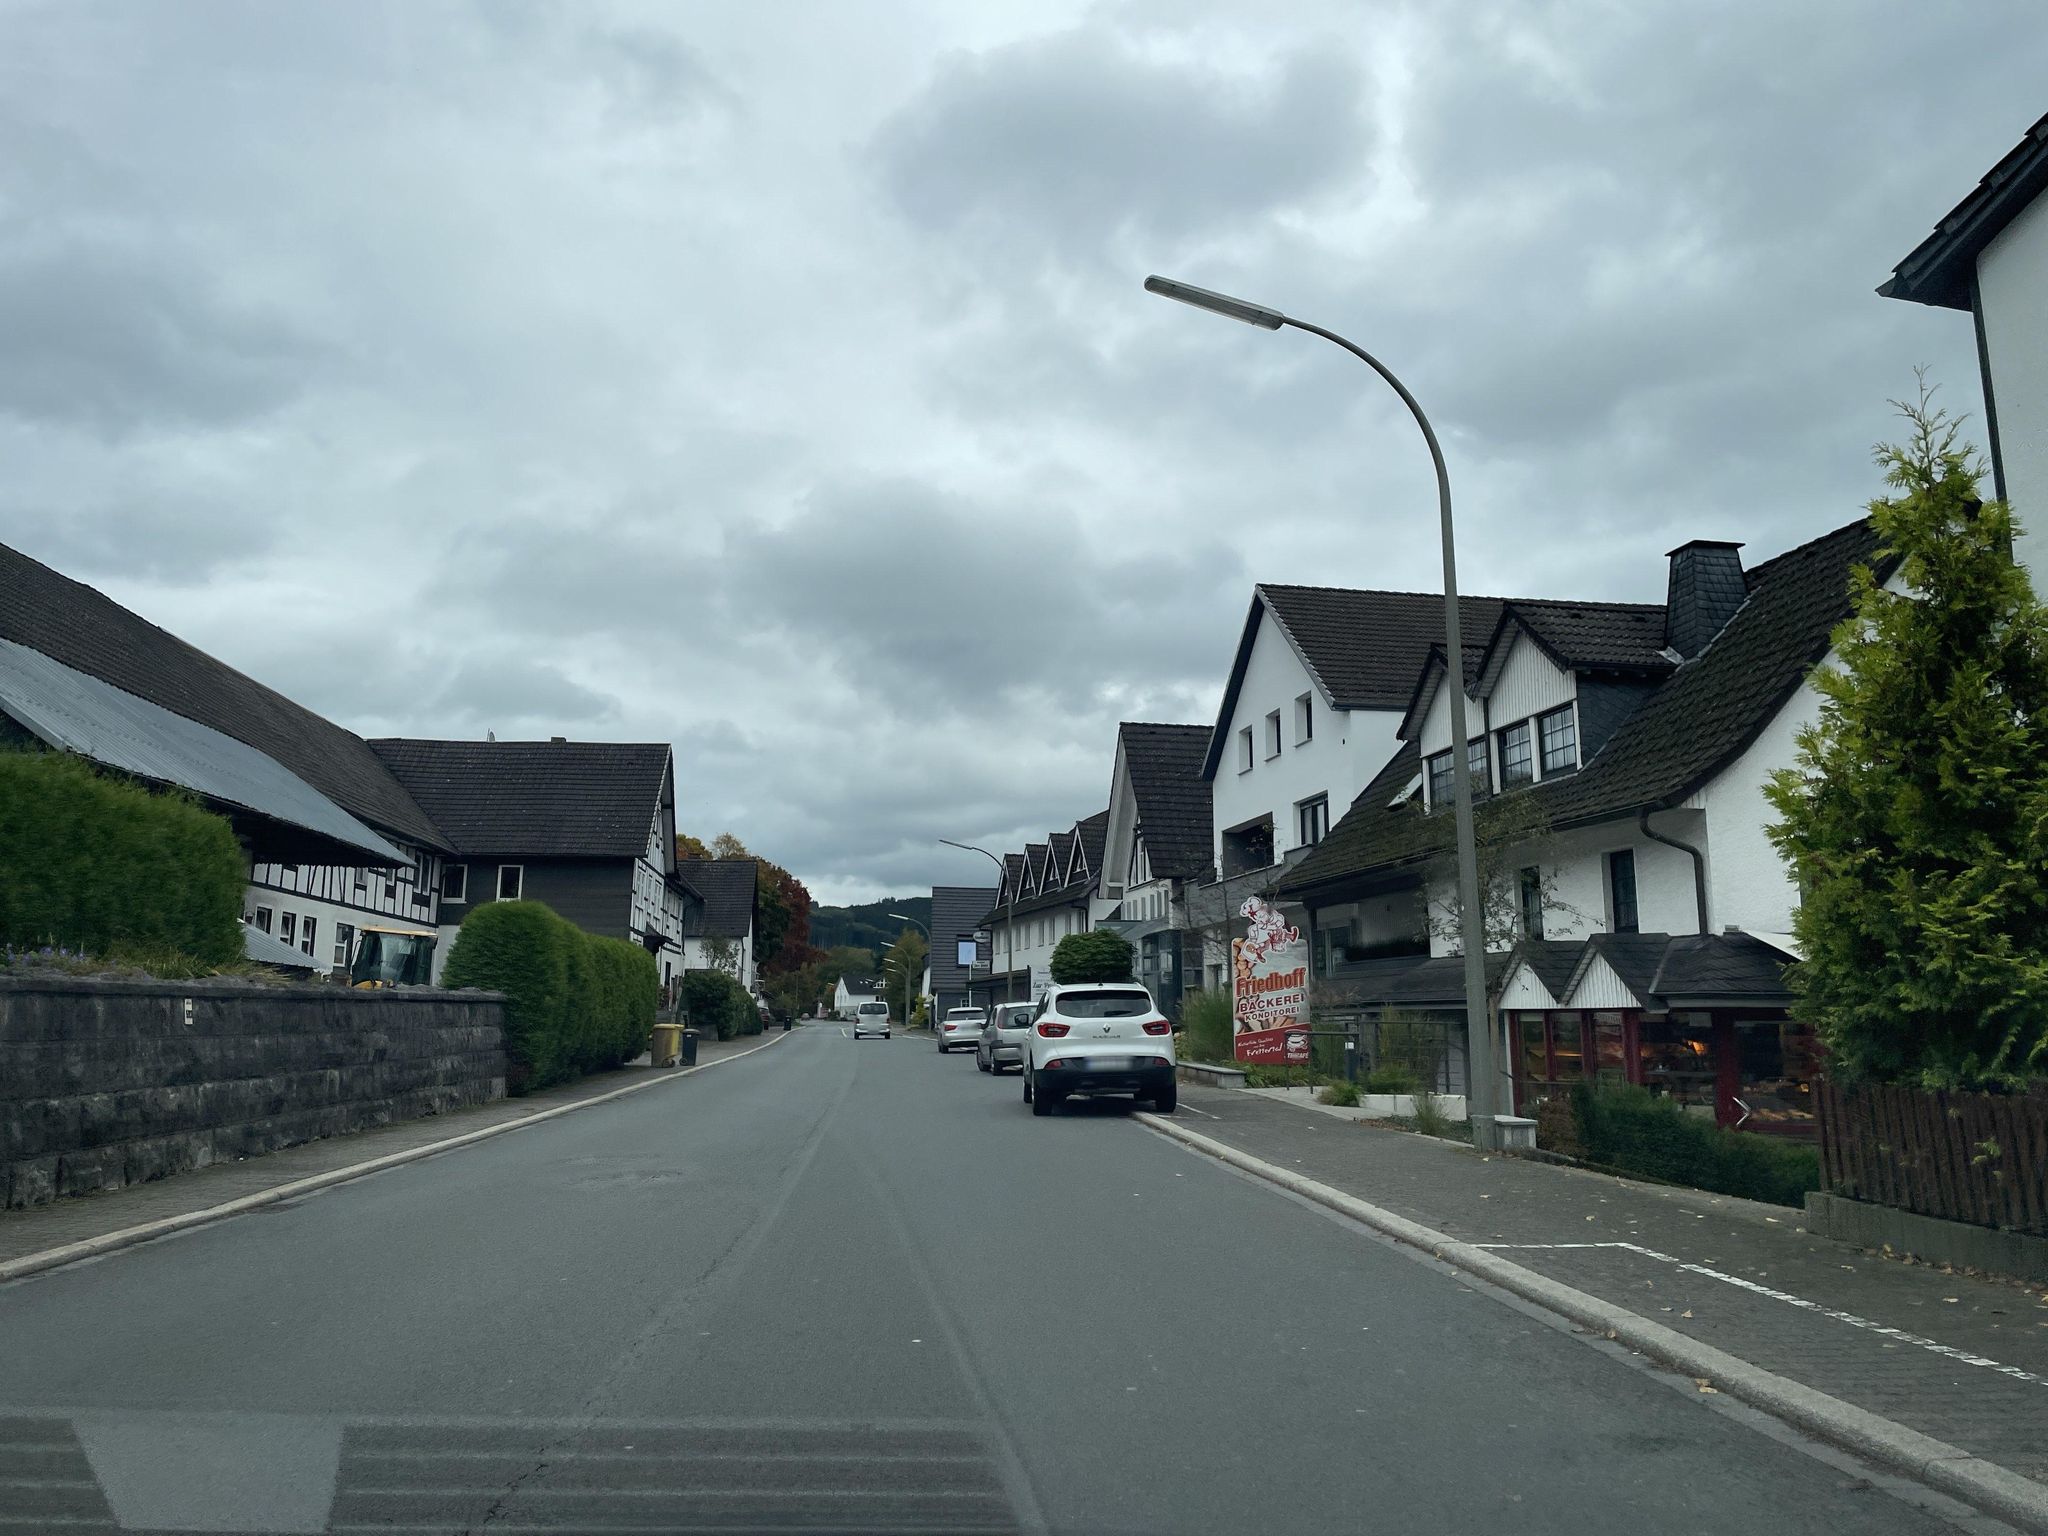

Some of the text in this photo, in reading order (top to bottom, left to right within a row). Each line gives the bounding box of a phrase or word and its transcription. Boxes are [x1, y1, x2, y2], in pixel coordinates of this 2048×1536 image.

[1236, 967, 1306, 997] Friedhoff
[1240, 993, 1304, 1012] BÄCKEREI
[1245, 1006, 1300, 1021] KONDITOREI
